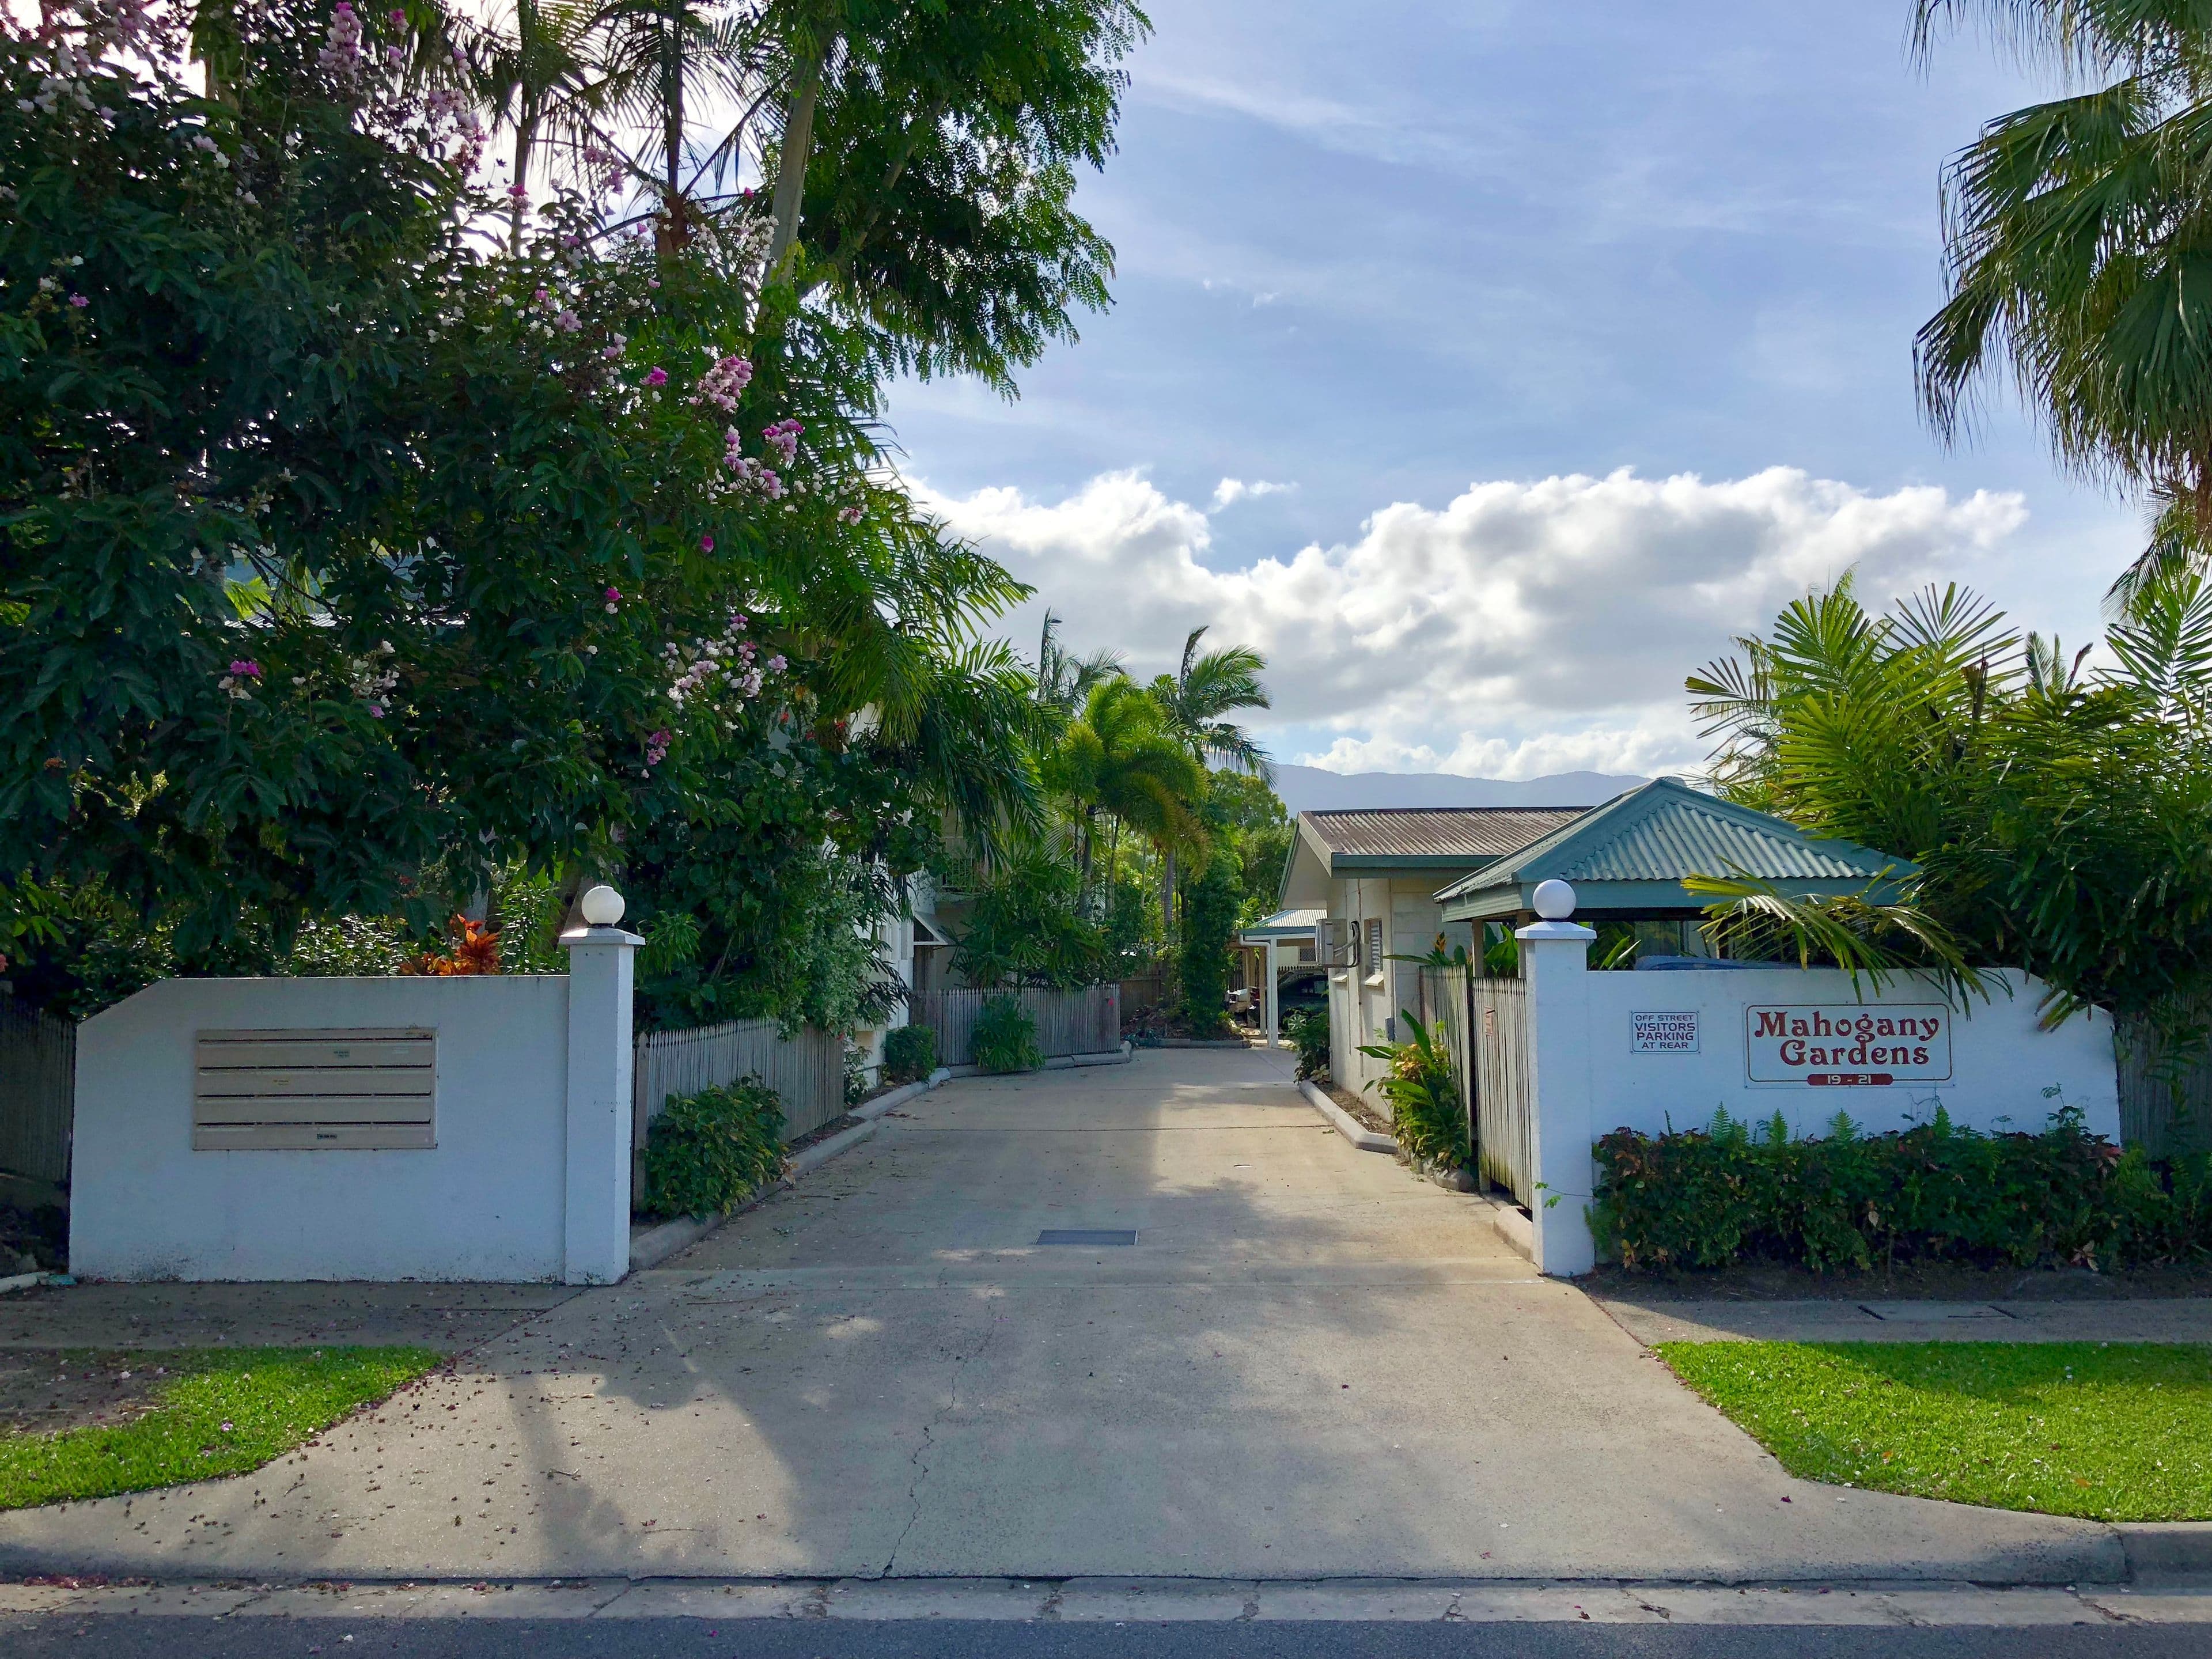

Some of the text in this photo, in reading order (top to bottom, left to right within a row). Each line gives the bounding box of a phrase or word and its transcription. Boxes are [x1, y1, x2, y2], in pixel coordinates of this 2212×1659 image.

[1634, 1022, 1696, 1032] VISITORS
[1754, 1010, 1940, 1043] Mahogany
[1637, 1032, 1694, 1041] PARKING
[1780, 1037, 1930, 1066] Gardens
[1827, 1075, 1842, 1085] 19
[1858, 1075, 1872, 1085] 21
